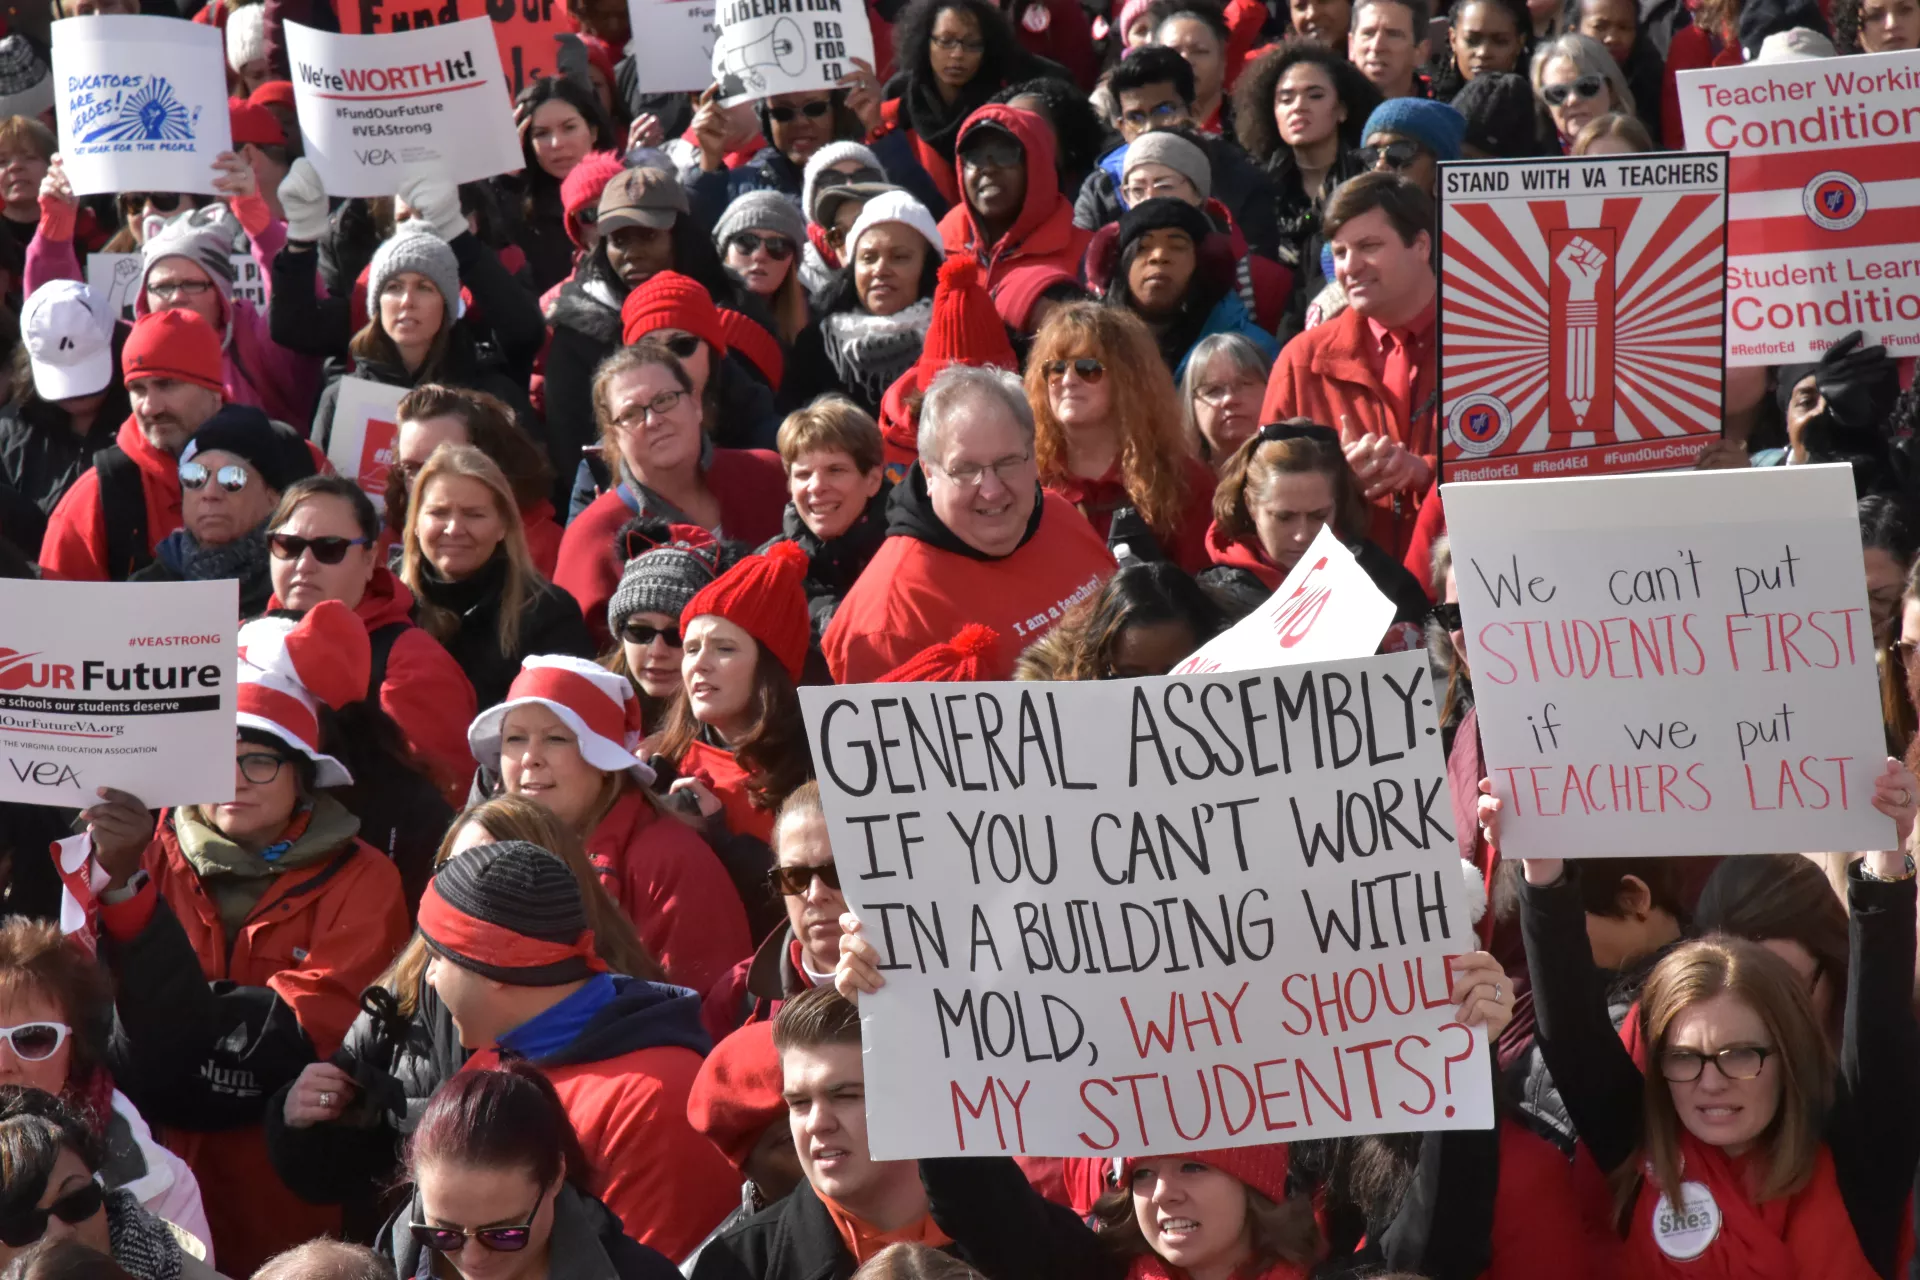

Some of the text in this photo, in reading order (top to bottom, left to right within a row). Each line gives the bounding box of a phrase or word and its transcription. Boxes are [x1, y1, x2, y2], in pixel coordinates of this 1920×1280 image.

[723, 0, 842, 27] LIBERATION
[813, 21, 842, 39] RED
[815, 41, 845, 60] FOR
[68, 74, 143, 92] EDUCATORS
[822, 63, 843, 81] ED
[69, 92, 95, 112] ARE
[1699, 79, 1816, 107] Teacher
[336, 102, 443, 119] #FundOurFuture
[352, 122, 432, 138] #VEAStrong
[114, 144, 132, 152] FOR
[136, 142, 157, 151] THE
[160, 142, 197, 152] PEOPLE
[1447, 162, 1719, 193] STAND WITH VA TEACHERS
[1727, 261, 1838, 290] Student
[1731, 287, 1920, 331] Conditio
[1731, 341, 1795, 356] #RedforEd
[1453, 463, 1519, 482] #RedforEd
[1533, 455, 1589, 474] #Red4Ed
[1471, 544, 1800, 618] We can't put
[1026, 613, 1049, 631] am
[1048, 606, 1060, 619] a
[128, 634, 221, 647] #VEASTRONG
[1479, 608, 1863, 685] STUDENTS FIRST
[82, 660, 221, 691] Future
[8, 697, 53, 710] schools
[55, 701, 76, 712] our
[78, 701, 130, 713] students
[133, 700, 180, 711] deserve
[820, 666, 1436, 797] GENERAL ASSEMBLY:
[1527, 702, 1795, 761] if we put
[4, 739, 158, 755] THE VIRGINIA EDUCATION ASSOCIATION
[1495, 756, 1853, 817] TEACHERS LAST
[845, 776, 1455, 885] IF YOU CAN'T WORK
[862, 870, 1451, 975] IN A BUILDING WITH
[933, 988, 1098, 1066] MOLD,
[1120, 981, 1249, 1059] WHY
[950, 1022, 1475, 1153] MY STUDENTS?
